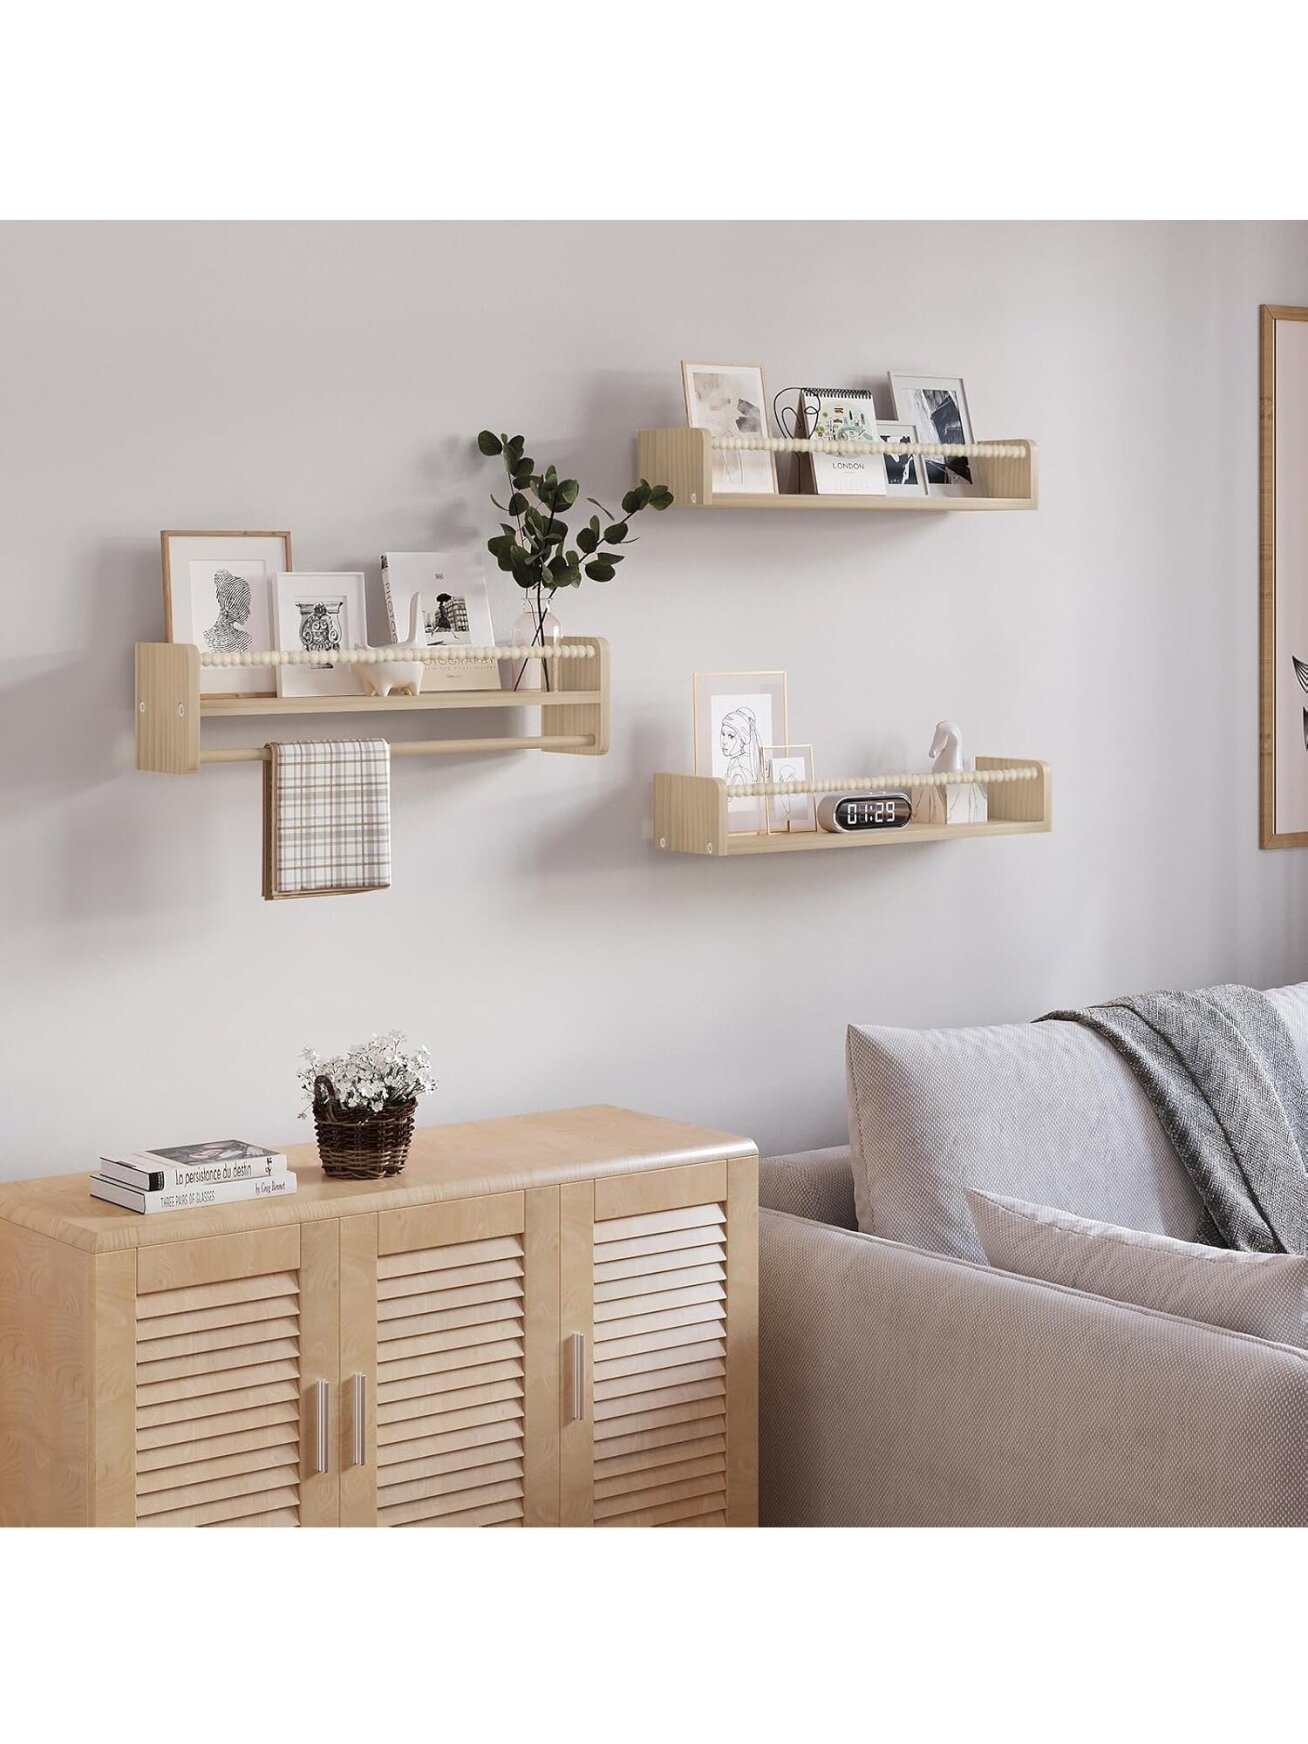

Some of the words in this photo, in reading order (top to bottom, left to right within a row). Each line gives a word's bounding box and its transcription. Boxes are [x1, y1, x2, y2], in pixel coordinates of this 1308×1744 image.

[832, 462, 865, 470] LONDON
[847, 801, 895, 825] 01:29
[222, 1162, 232, 1179] du
[233, 1160, 252, 1177] destin
[160, 1196, 175, 1208] THREE
[175, 1194, 188, 1207] PAIRS
[188, 1193, 195, 1205] OF
[196, 1190, 216, 1204] GLASSES
